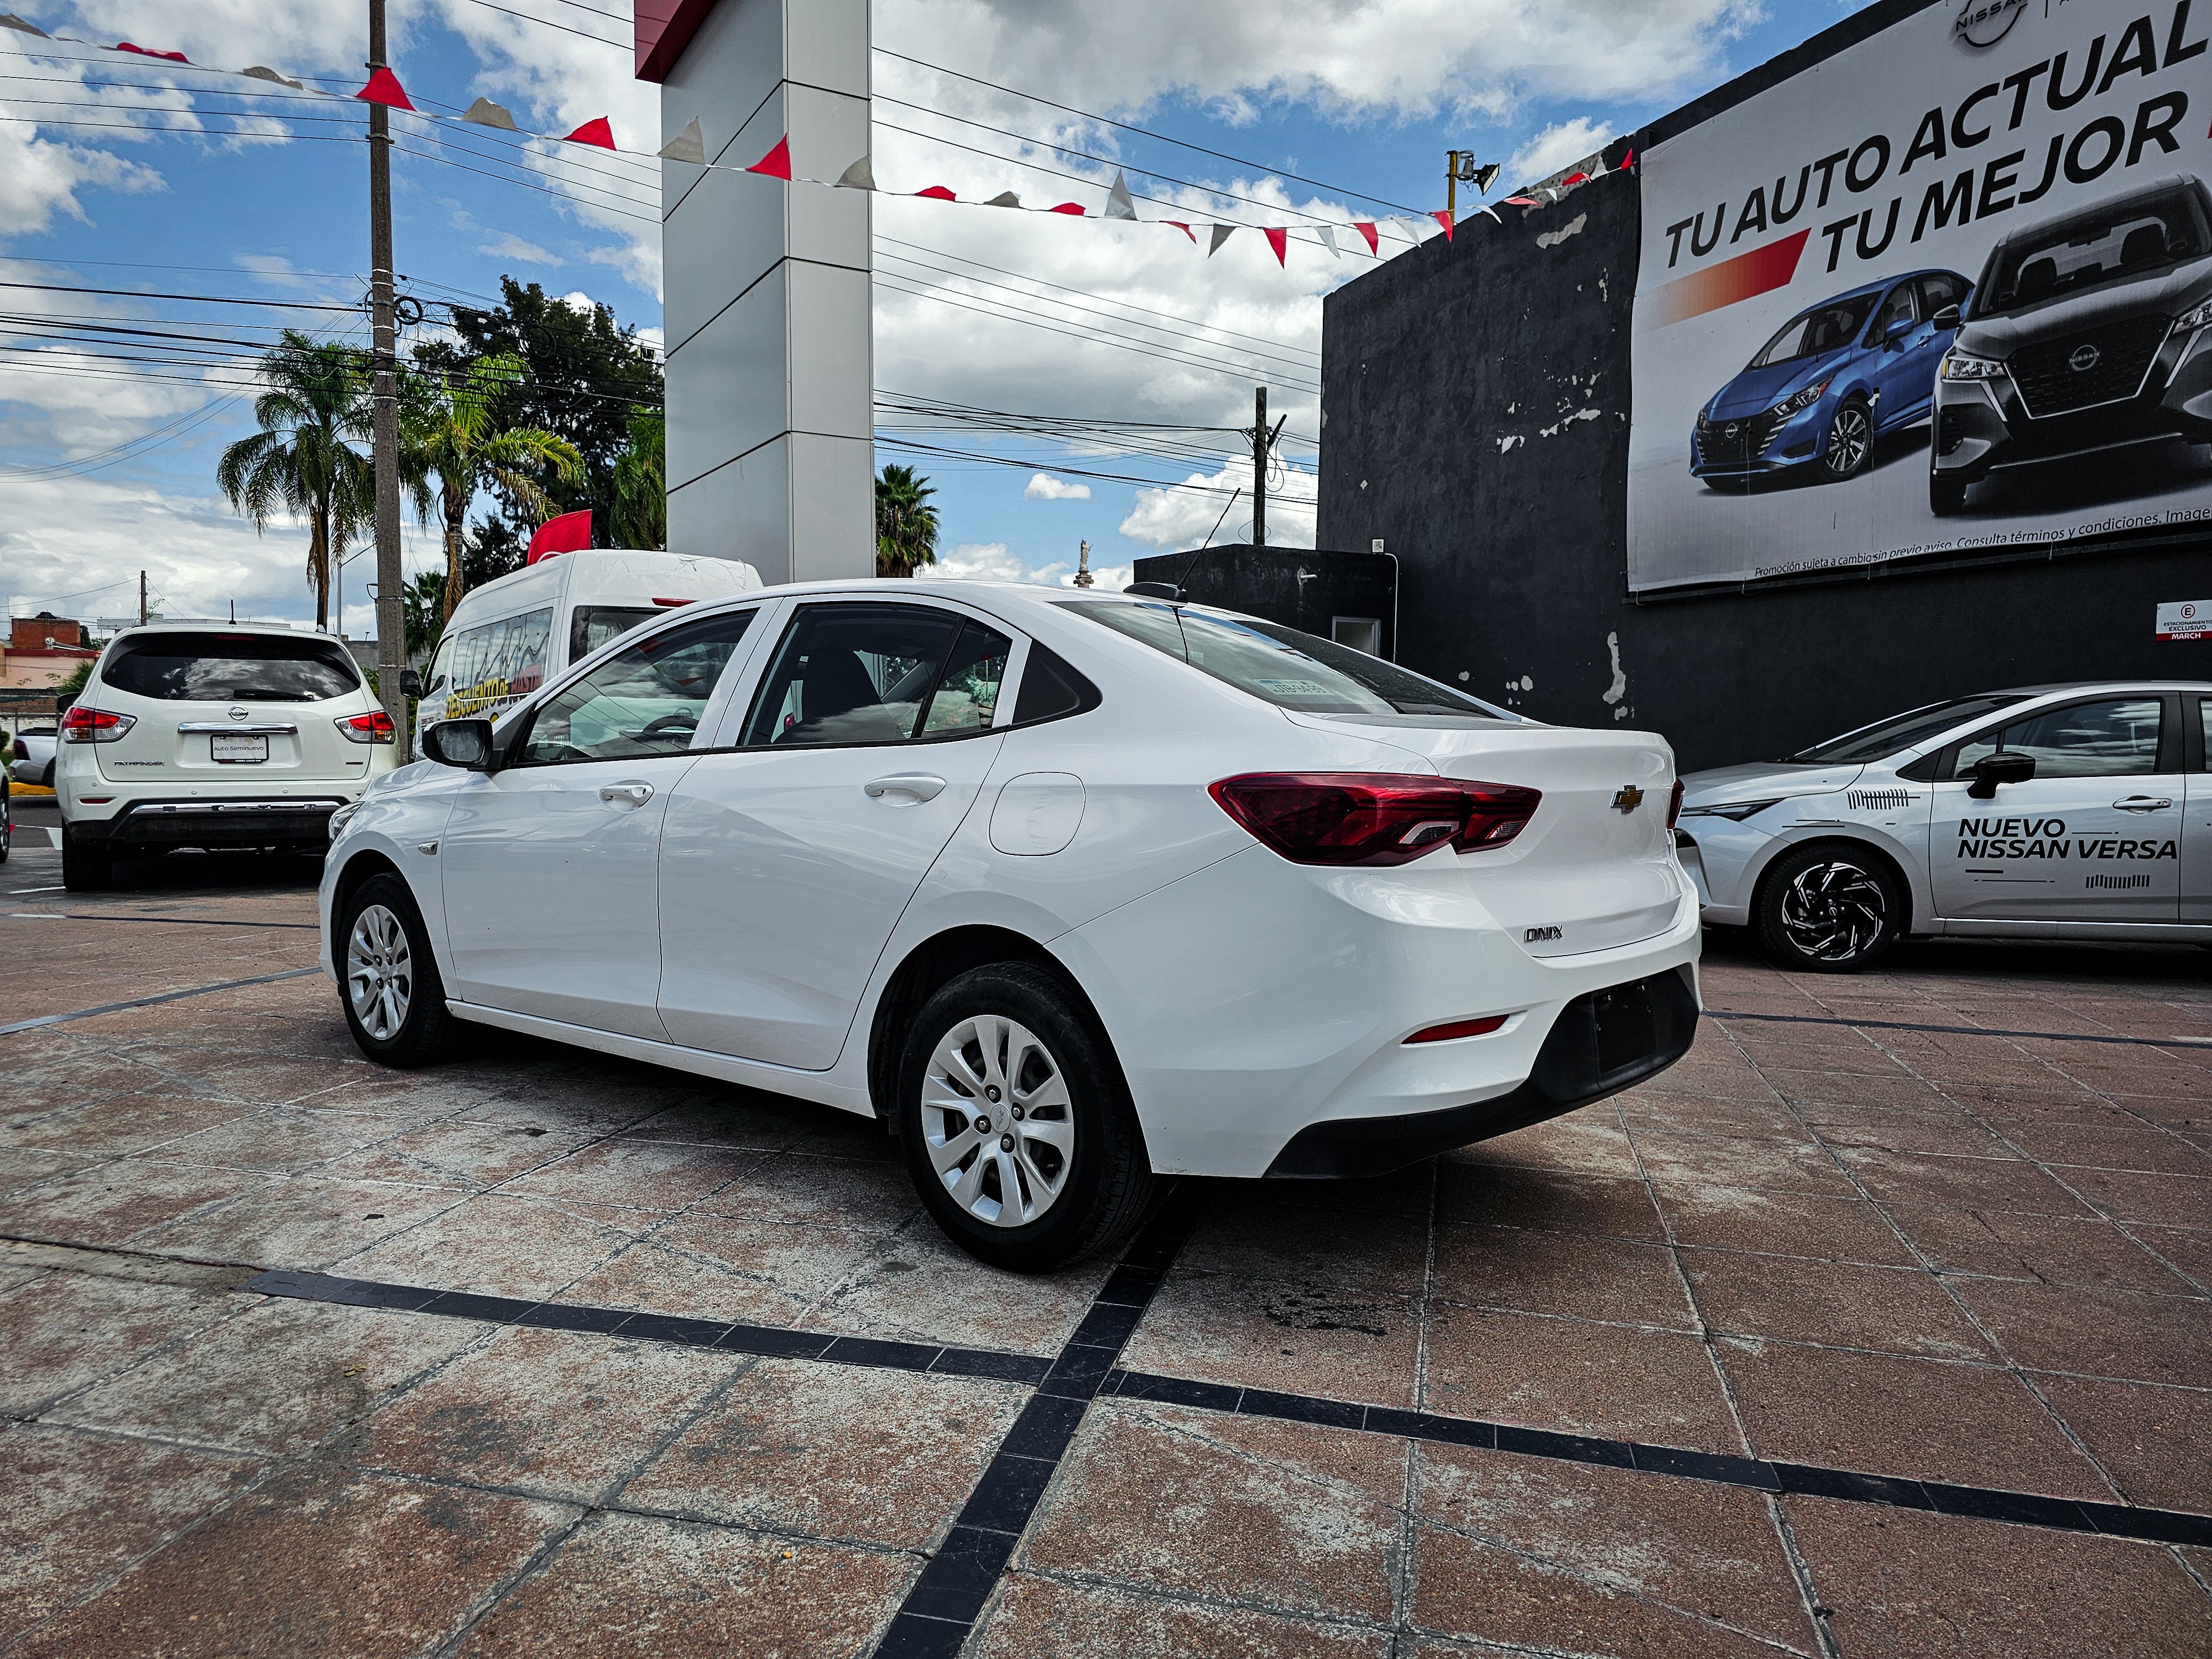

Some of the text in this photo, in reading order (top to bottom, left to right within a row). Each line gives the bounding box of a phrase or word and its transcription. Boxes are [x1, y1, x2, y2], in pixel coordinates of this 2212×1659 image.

[1956, 0, 2021, 32] NISSA
[1666, 0, 2209, 269] TU AUTO ACTUAL
[1822, 91, 2189, 273] TU MEJOR
[1755, 561, 1800, 577] Promoción
[1803, 559, 1829, 570] sujeta
[1838, 553, 1871, 565] cambio
[1874, 550, 1887, 561] sin
[1889, 545, 1922, 560] previo
[1957, 533, 2007, 547] Consulta
[2011, 530, 2064, 542] términos
[2068, 527, 2076, 539] y
[2079, 518, 2161, 535] condiciones.
[2166, 508, 2212, 523] Image
[446, 676, 500, 719] DESCUENTO
[1958, 818, 2066, 838] NUEVO
[1957, 839, 2178, 859] NISSAN VERSA
[1524, 925, 1563, 942] ONIX
